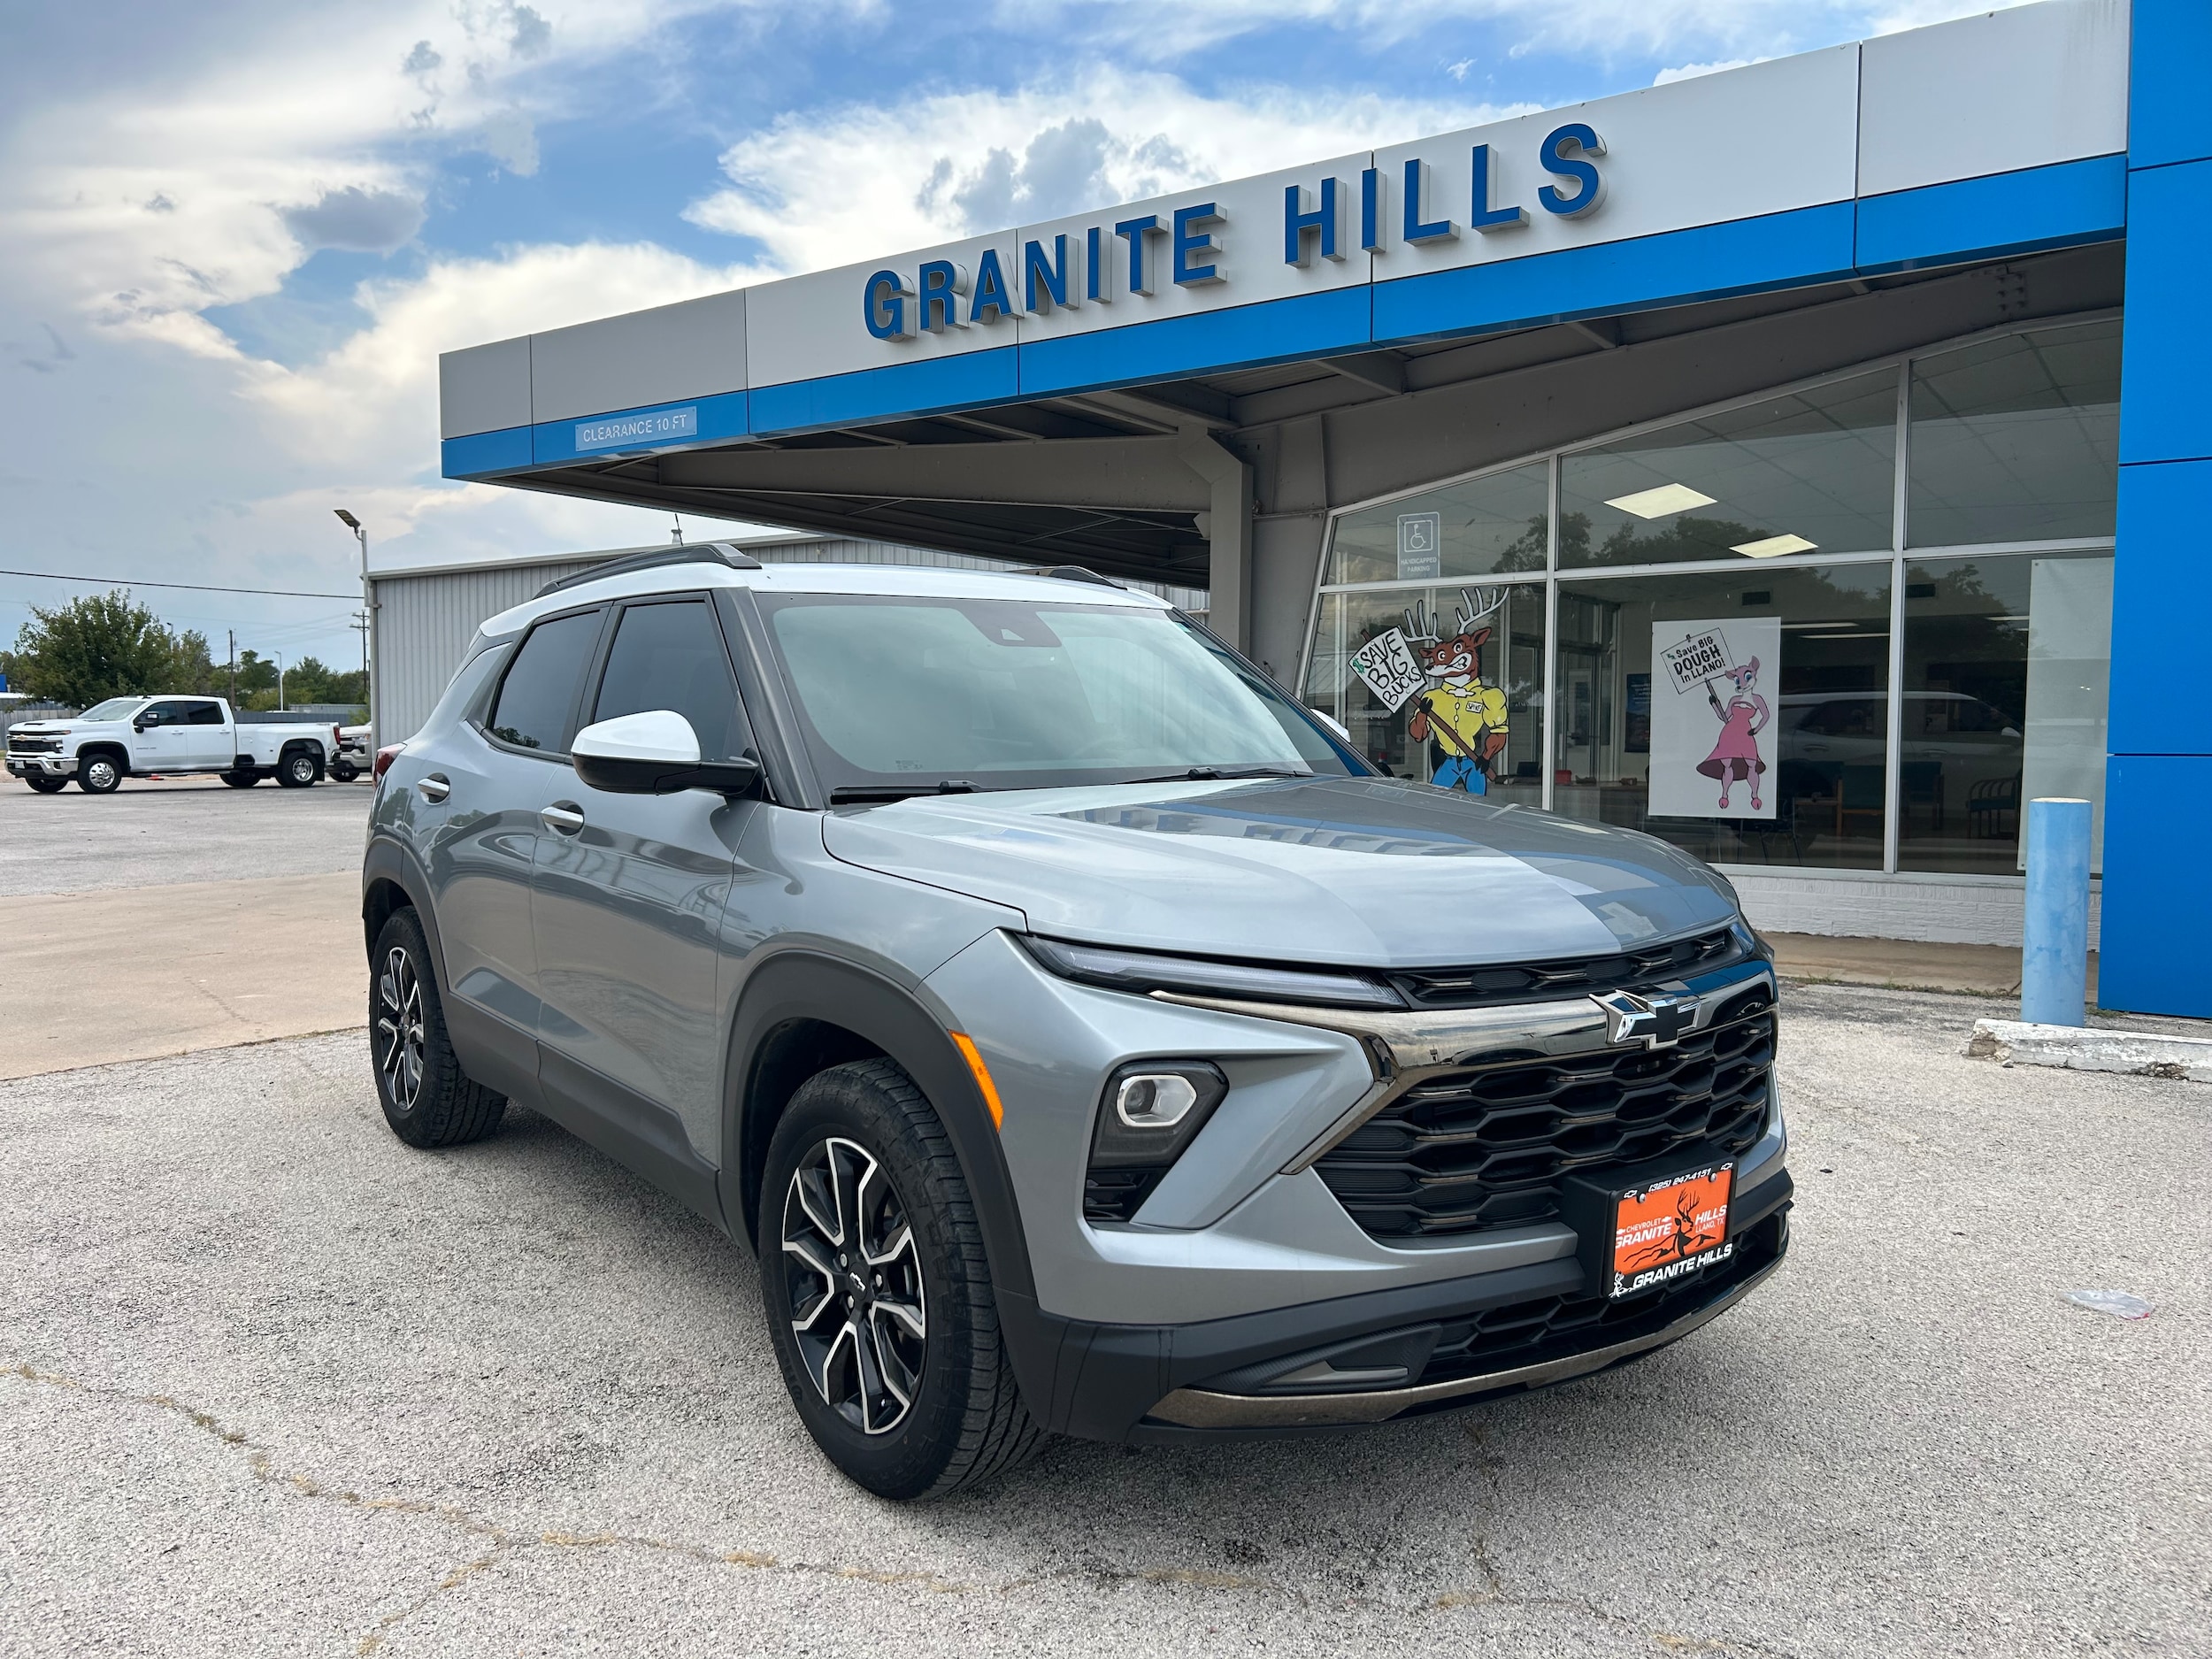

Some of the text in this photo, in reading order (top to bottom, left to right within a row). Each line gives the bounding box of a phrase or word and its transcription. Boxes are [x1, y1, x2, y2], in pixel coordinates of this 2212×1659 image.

[864, 123, 1605, 343] GRANITE HILLS
[583, 414, 687, 442] CLEARANCE 10 FT
[1400, 557, 1437, 565] HANDICAPPED
[1360, 631, 1402, 669] SAVE
[1673, 643, 1722, 675] DOUGH
[1676, 644, 1697, 658] Save
[1698, 635, 1714, 649] BIG
[1367, 651, 1409, 689] BIG
[1691, 657, 1725, 680] LLANO!
[1382, 666, 1422, 706] BUCKS
[1648, 1167, 1712, 1192] (325) 247-4151
[1615, 1204, 1728, 1249] GRANITE HILLS
[1625, 1217, 1662, 1233] CHEVROLET
[1717, 1217, 1724, 1225] TX
[1632, 1243, 1733, 1289] GRANITE HILLS
